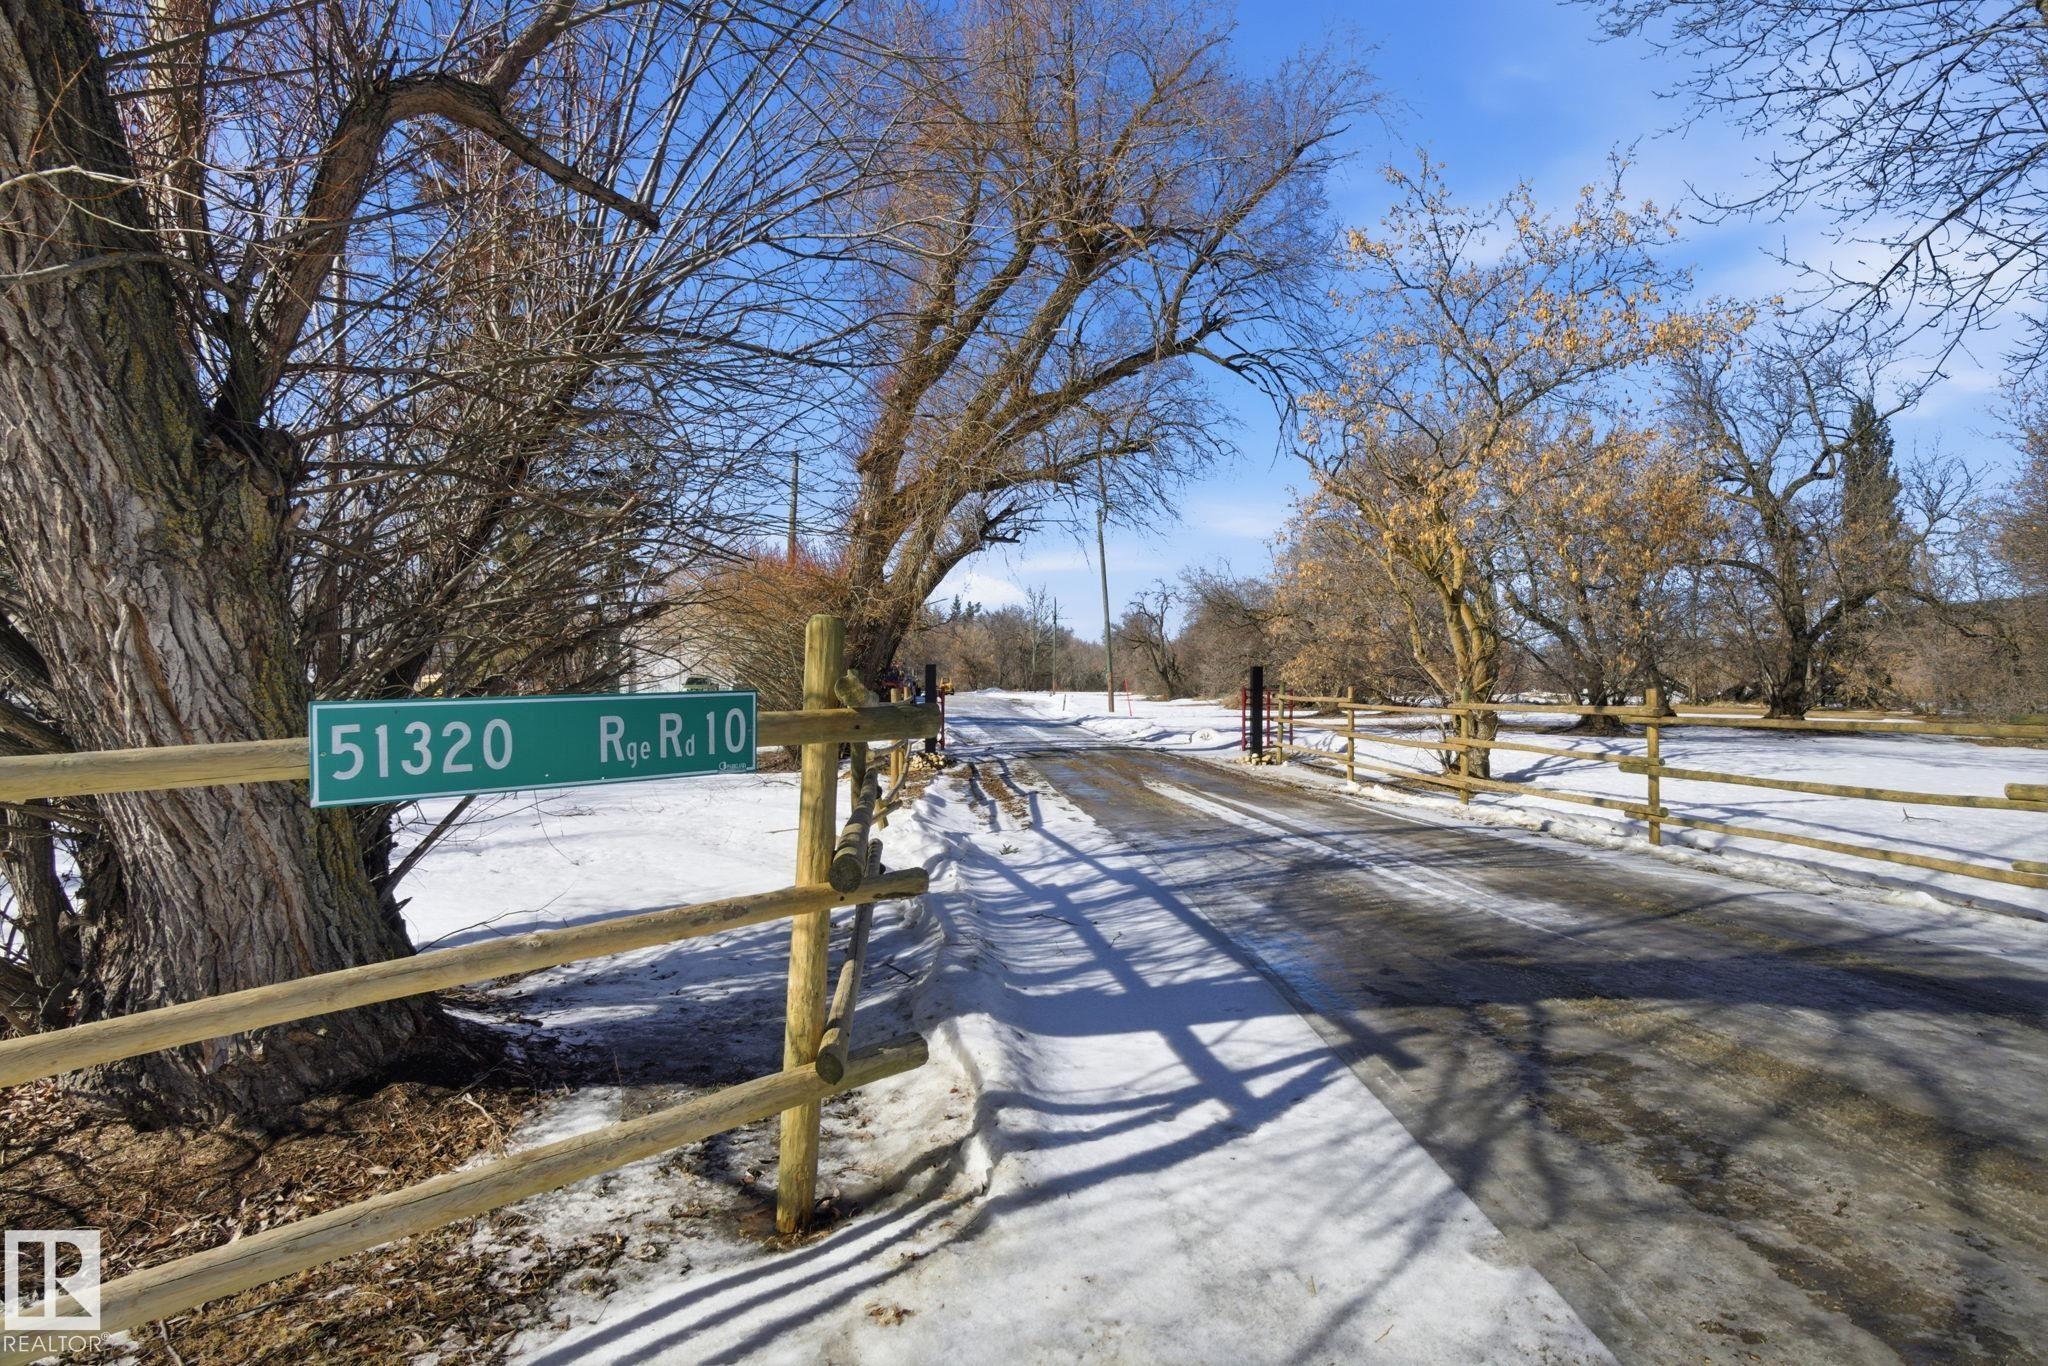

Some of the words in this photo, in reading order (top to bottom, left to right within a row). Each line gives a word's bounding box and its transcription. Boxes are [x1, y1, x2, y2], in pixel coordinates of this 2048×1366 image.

[330, 718, 513, 781] 51320
[599, 715, 651, 767] Rge
[659, 712, 695, 758] Rd
[706, 707, 746, 755] 10
